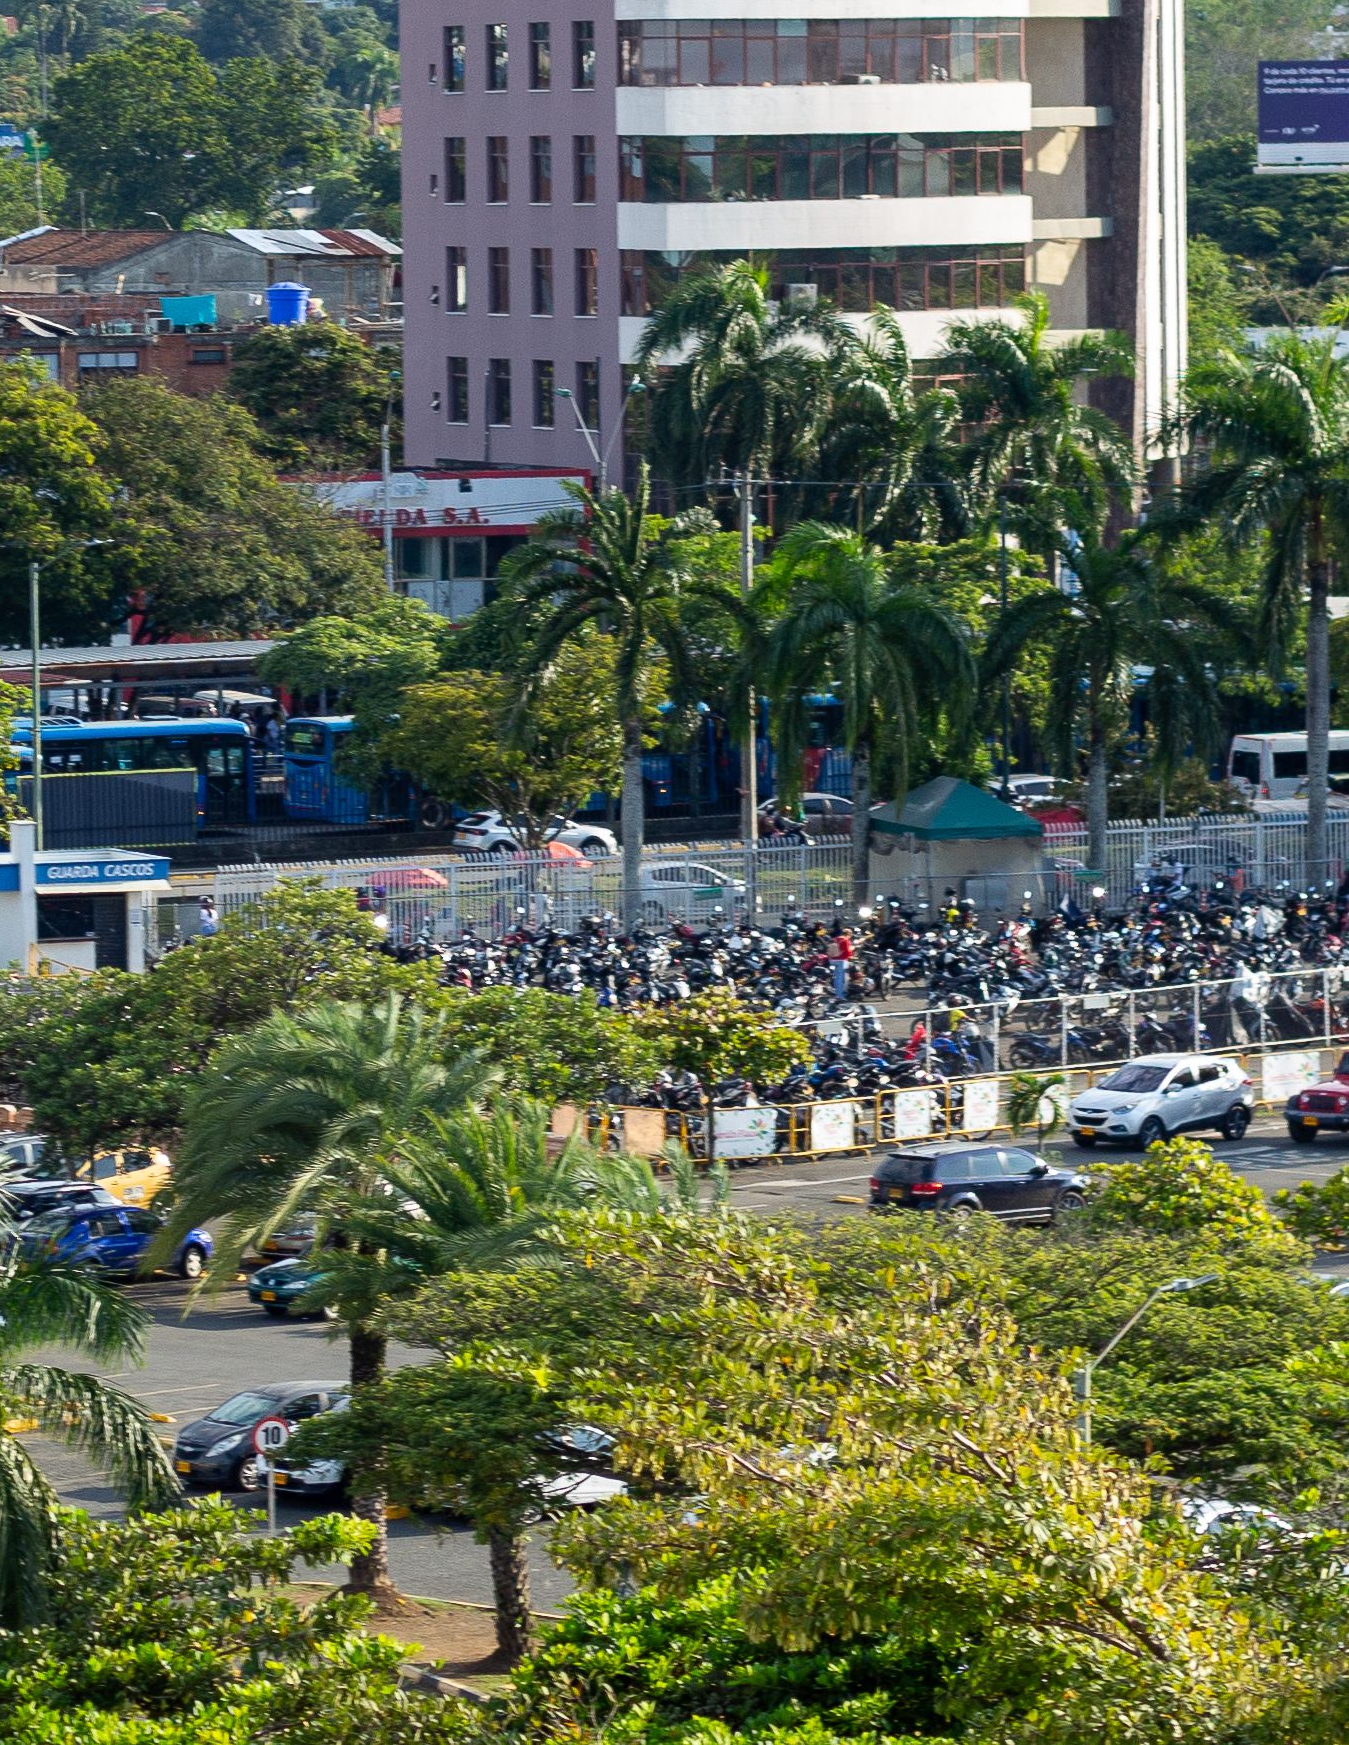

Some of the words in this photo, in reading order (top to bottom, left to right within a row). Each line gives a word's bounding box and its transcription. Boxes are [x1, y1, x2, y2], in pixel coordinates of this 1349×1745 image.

[47, 865, 99, 879] GUARDA
[104, 863, 155, 877] CASCOS
[261, 1425, 281, 1445] 10
